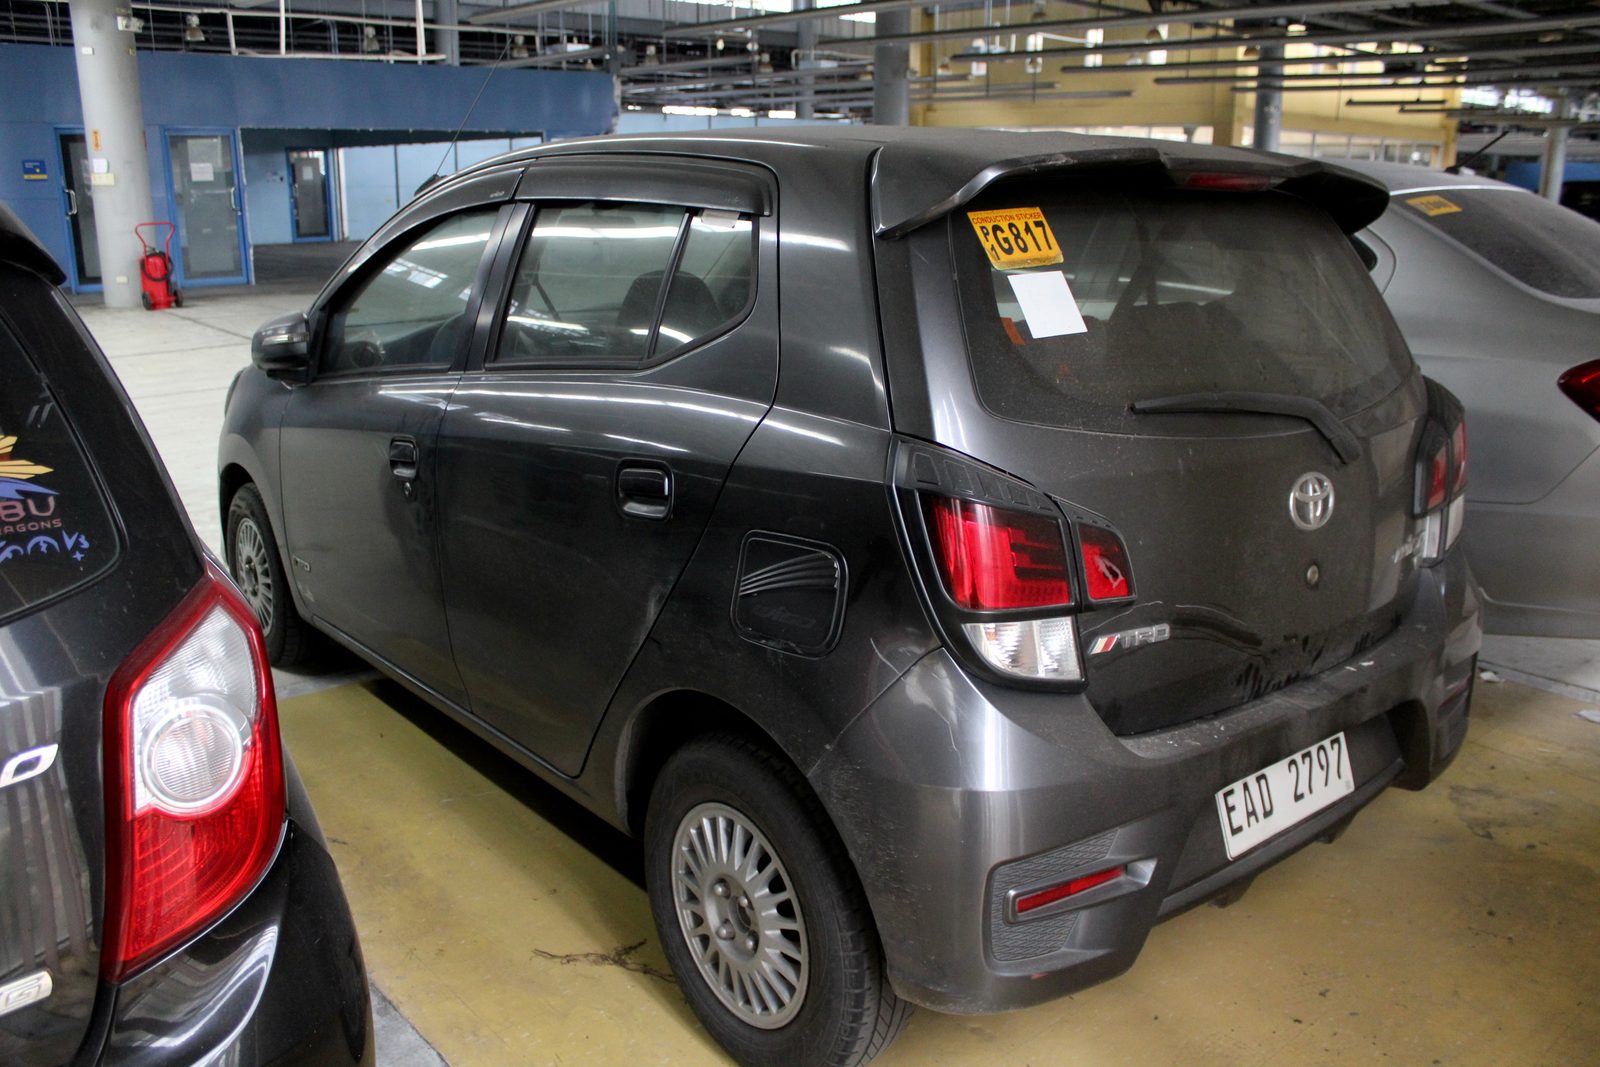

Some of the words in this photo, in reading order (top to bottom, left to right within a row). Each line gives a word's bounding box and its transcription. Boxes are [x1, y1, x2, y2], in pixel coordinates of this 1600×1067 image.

[972, 214, 1015, 225] CONDUCTION
[1016, 211, 1043, 221] STICKER
[991, 219, 1053, 256] G817
[0, 518, 63, 534] AGONS
[1119, 623, 1170, 649] TRD
[1222, 773, 1274, 837] EAD
[1287, 736, 1342, 803] 2797
